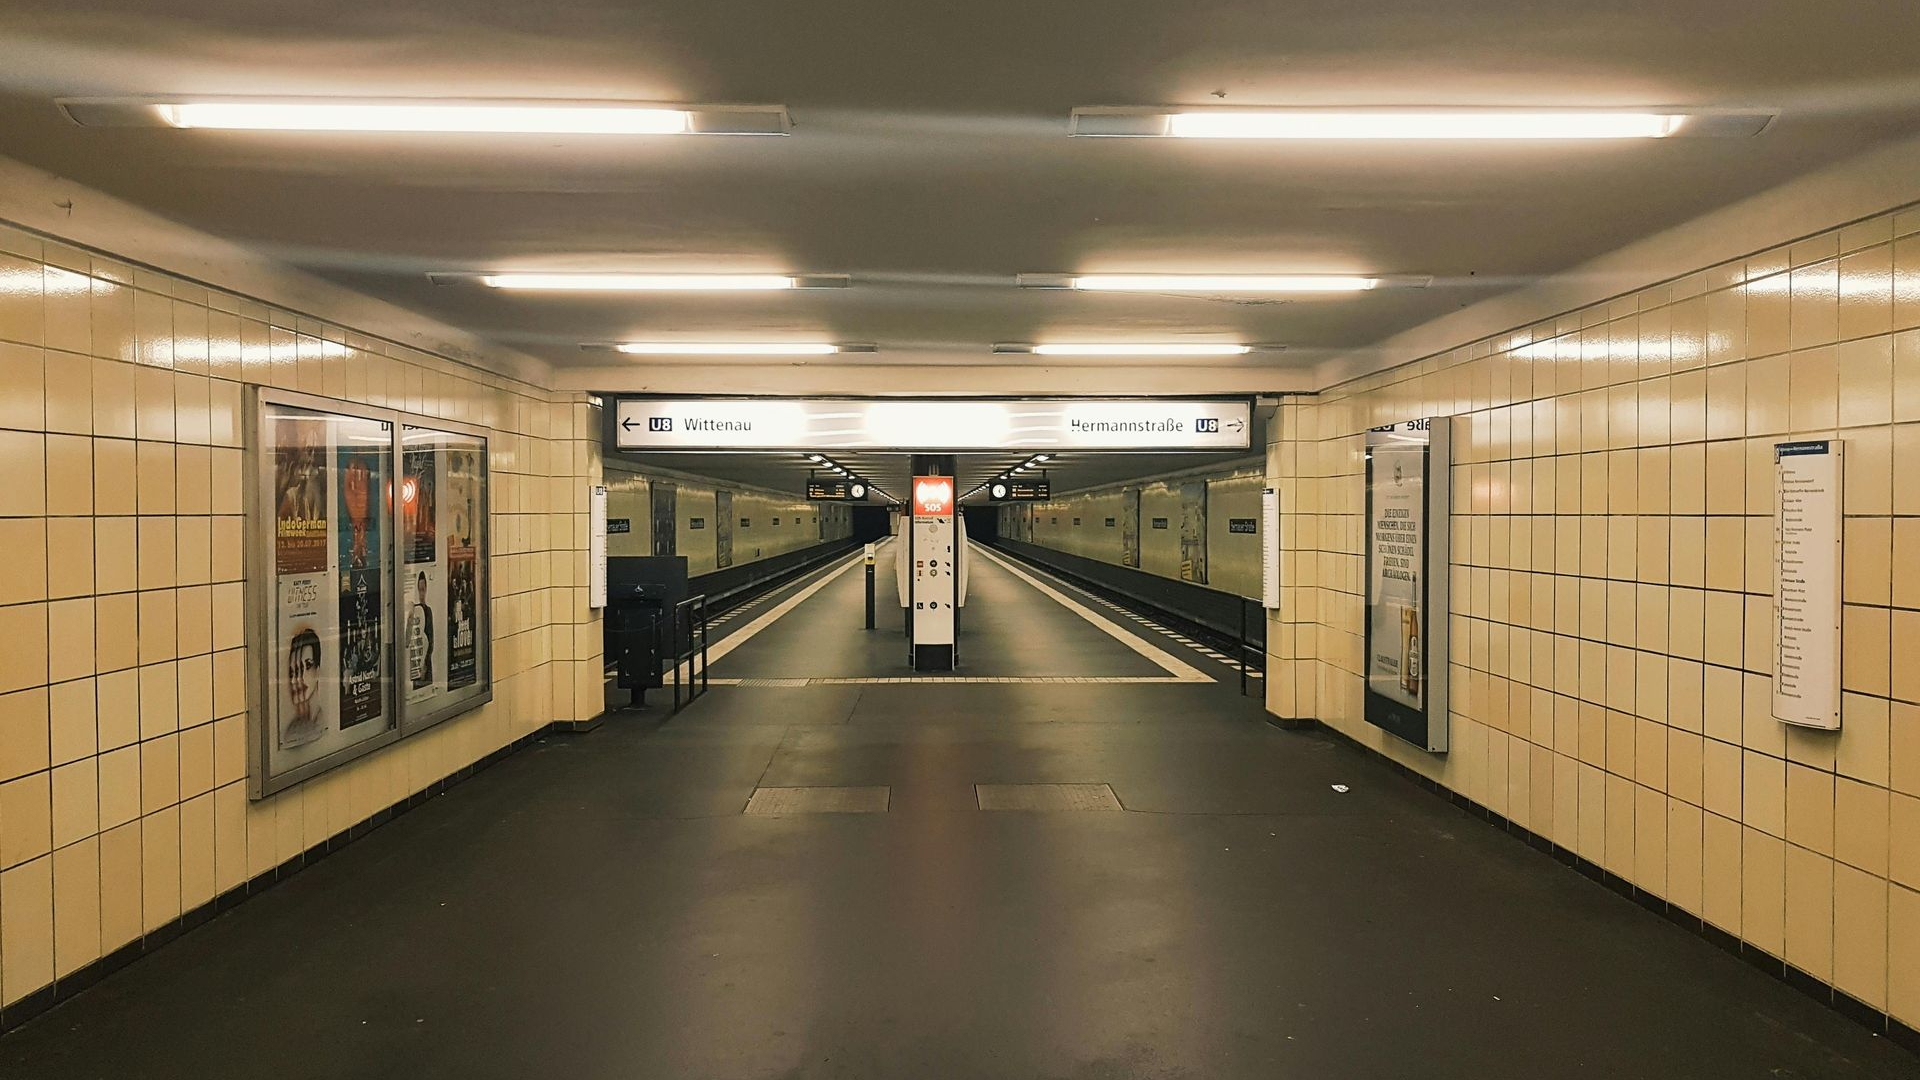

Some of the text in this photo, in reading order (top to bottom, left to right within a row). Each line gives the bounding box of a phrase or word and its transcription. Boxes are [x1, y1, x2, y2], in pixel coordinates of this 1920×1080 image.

[650, 418, 752, 431] U8 Wittenau
[1071, 418, 1218, 432] Hermannstraße U8
[924, 503, 942, 512] SOS
[278, 516, 326, 530] IndoGerman
